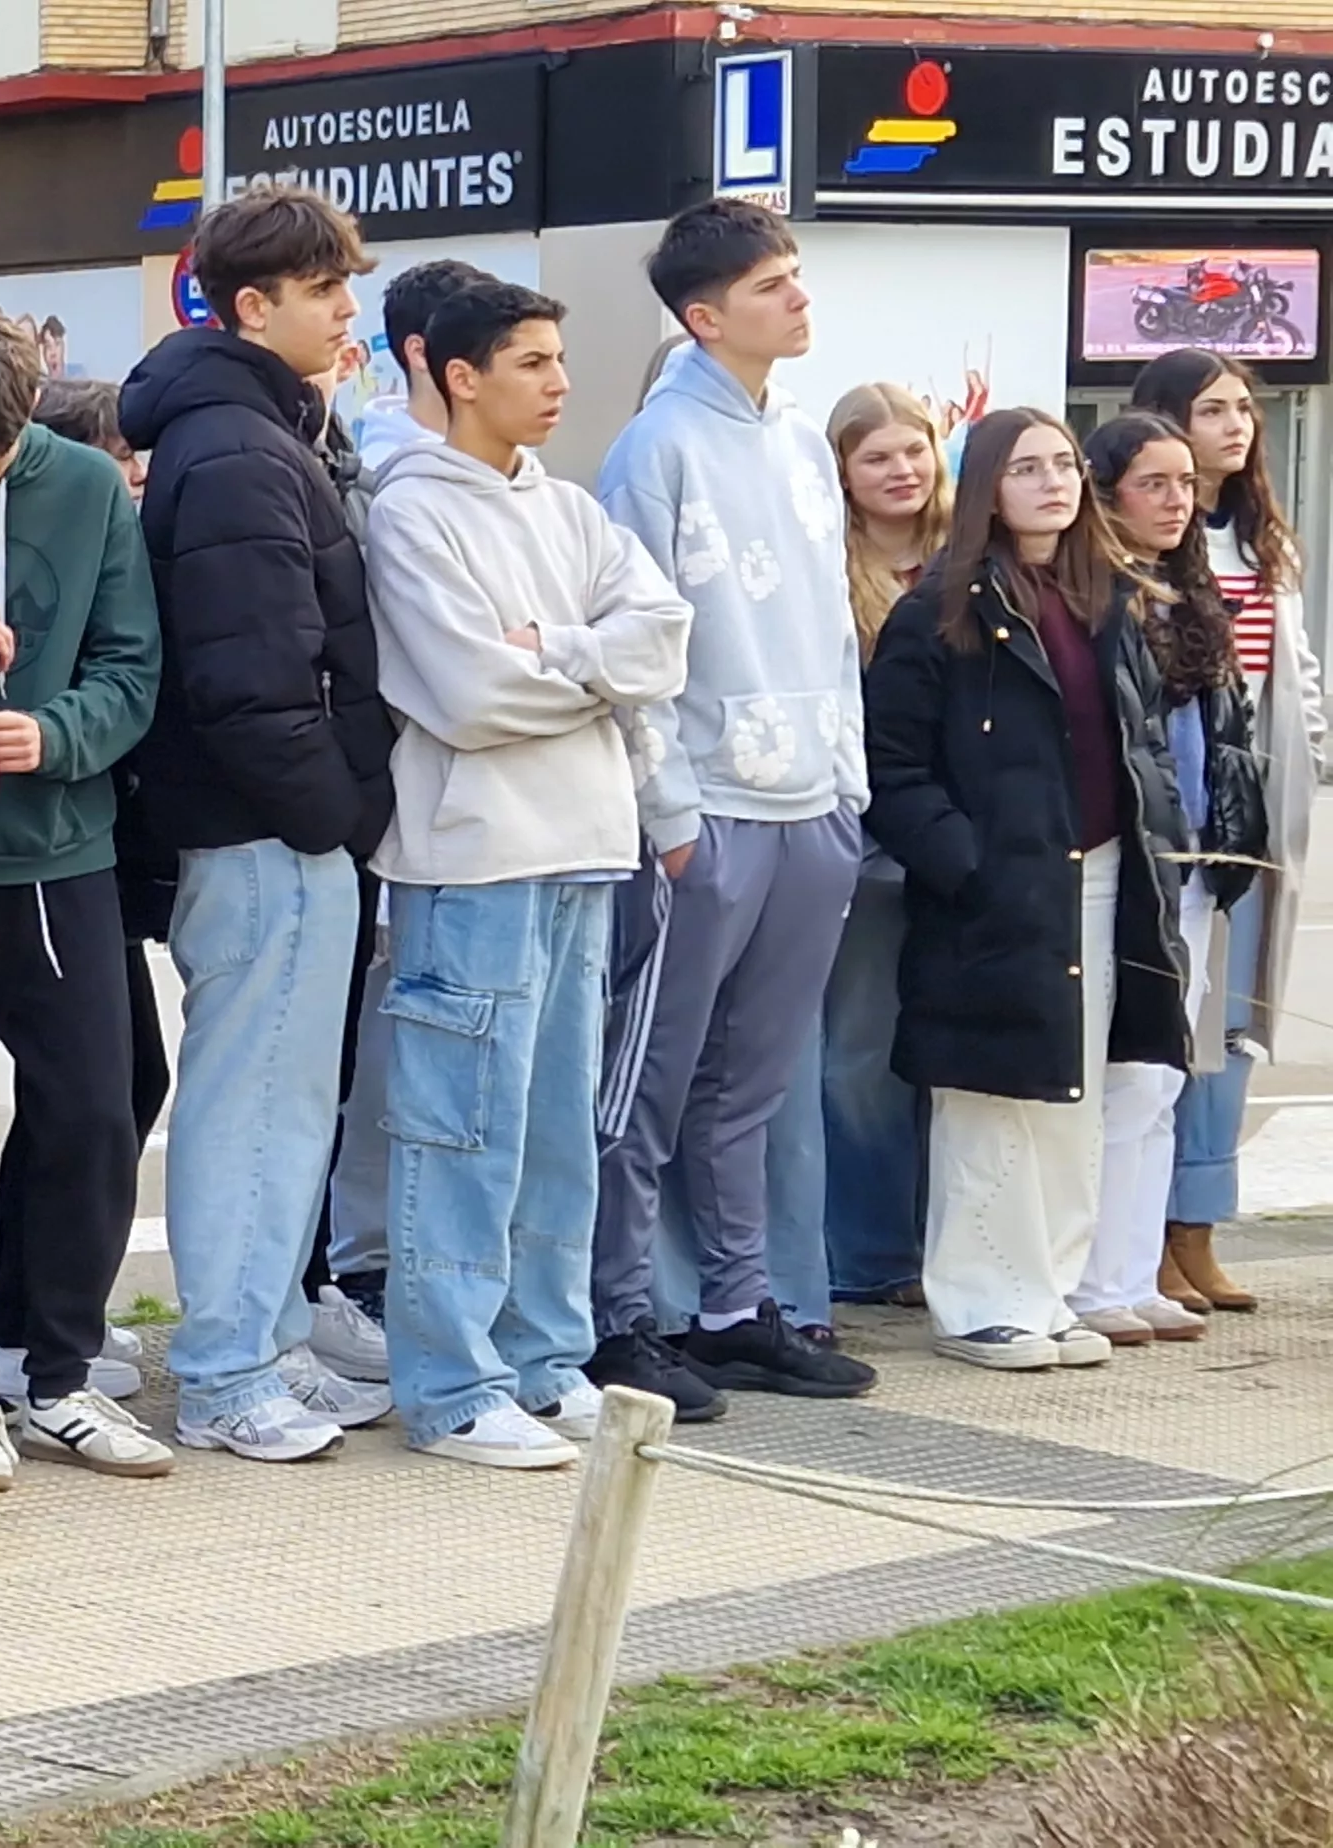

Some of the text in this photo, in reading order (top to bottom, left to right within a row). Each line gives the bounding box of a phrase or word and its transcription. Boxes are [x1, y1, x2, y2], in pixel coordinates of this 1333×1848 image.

[1142, 67, 1331, 106] AUTOESC
[263, 99, 472, 151] AUTOESCUELA
[725, 68, 778, 180] L
[1052, 116, 1333, 177] ESTUDIA
